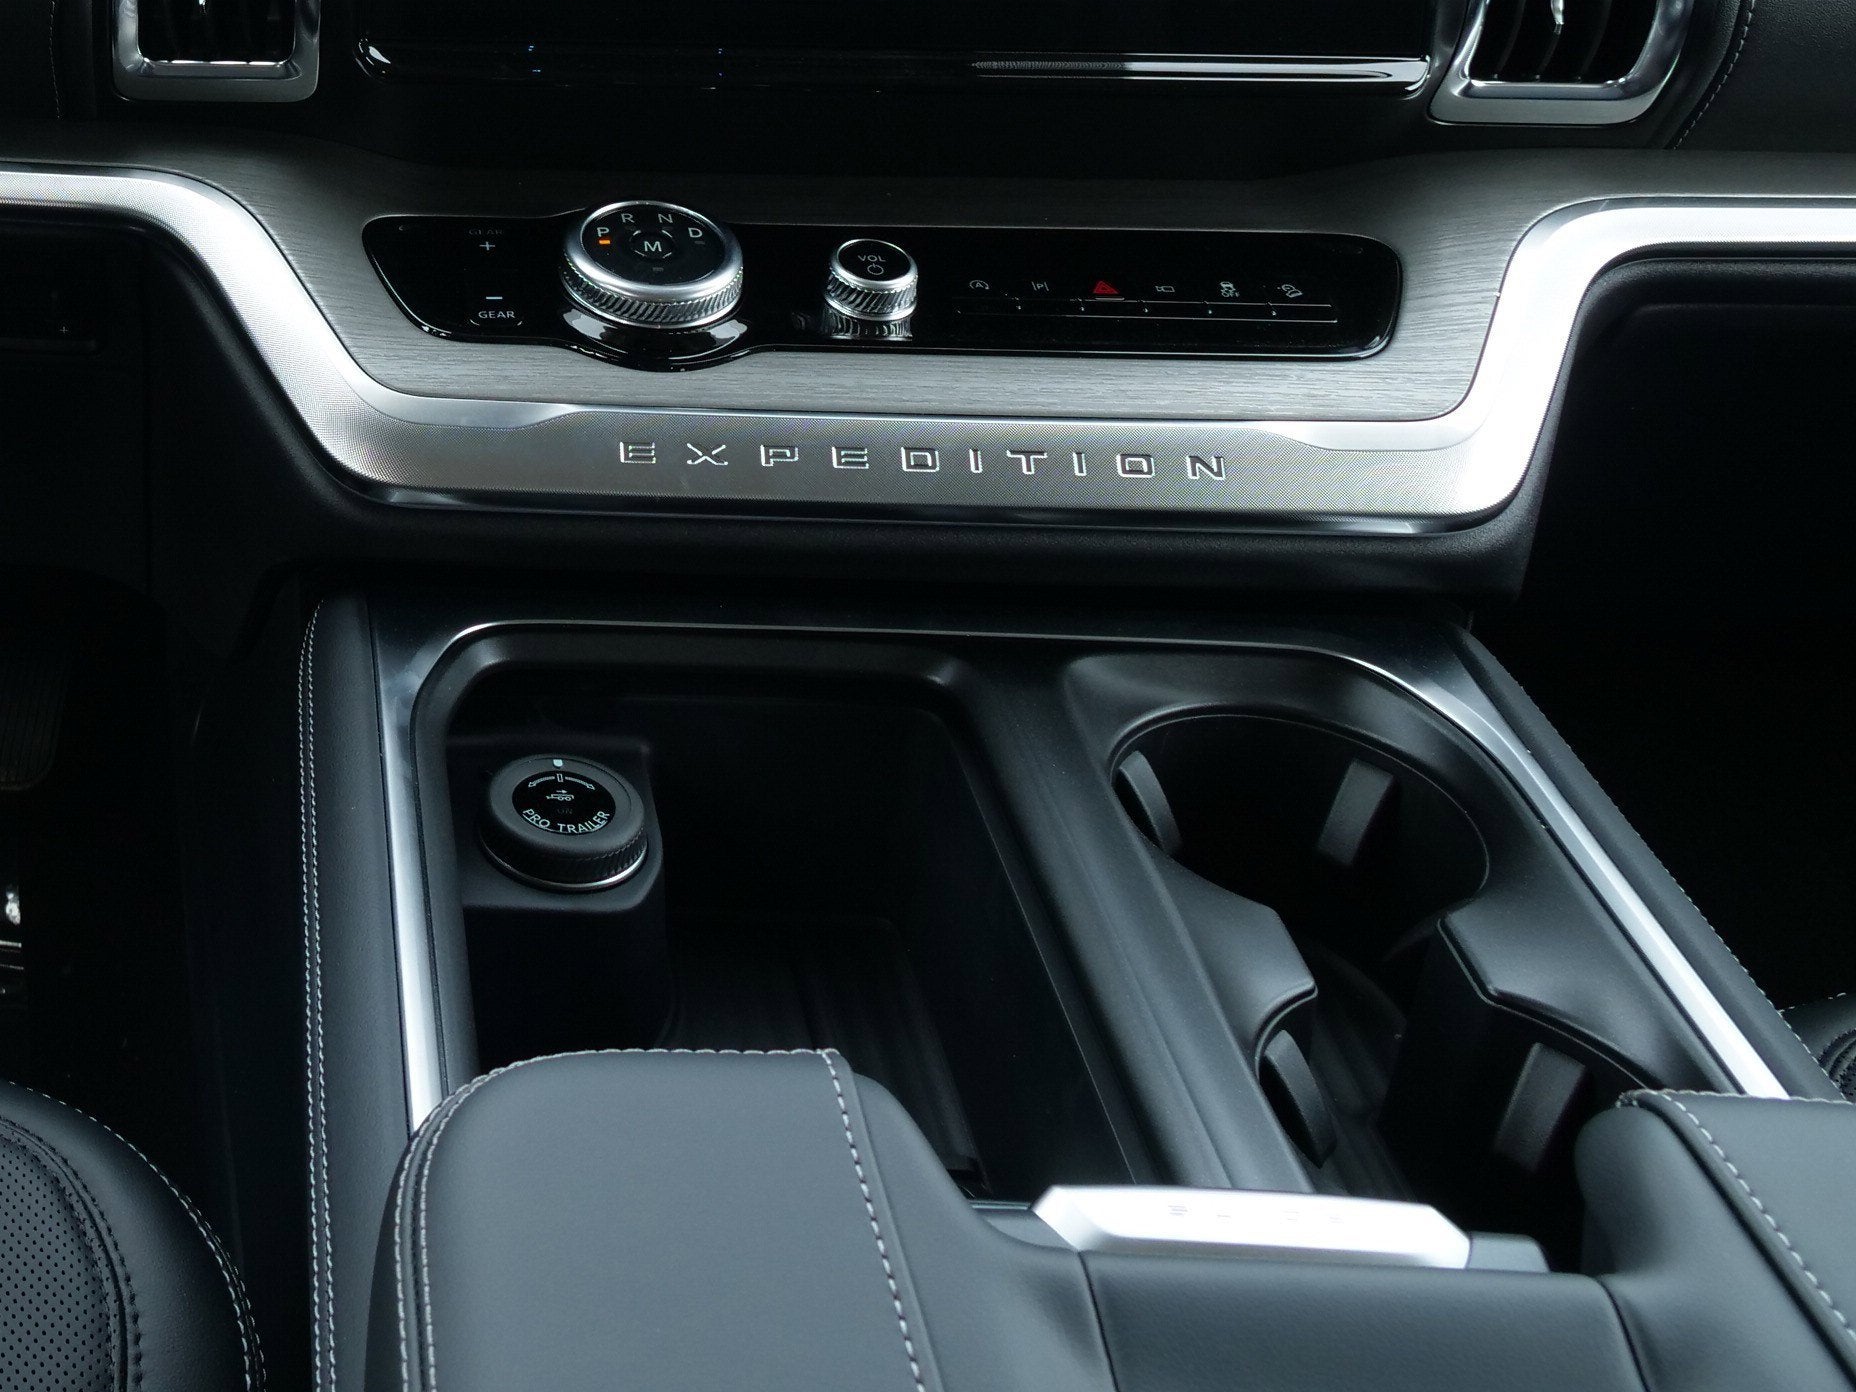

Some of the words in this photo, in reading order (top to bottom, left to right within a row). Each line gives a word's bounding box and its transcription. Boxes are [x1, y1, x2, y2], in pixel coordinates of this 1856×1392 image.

[621, 213, 634, 223] R
[657, 213, 674, 224] N
[596, 227, 610, 238] P
[687, 227, 703, 238] D
[643, 240, 663, 252] M
[857, 254, 886, 263] VOL
[478, 310, 515, 319] GEAR
[619, 440, 1227, 481] EXPEDITION
[523, 808, 551, 829] PRO
[557, 810, 611, 834] TRAILER
